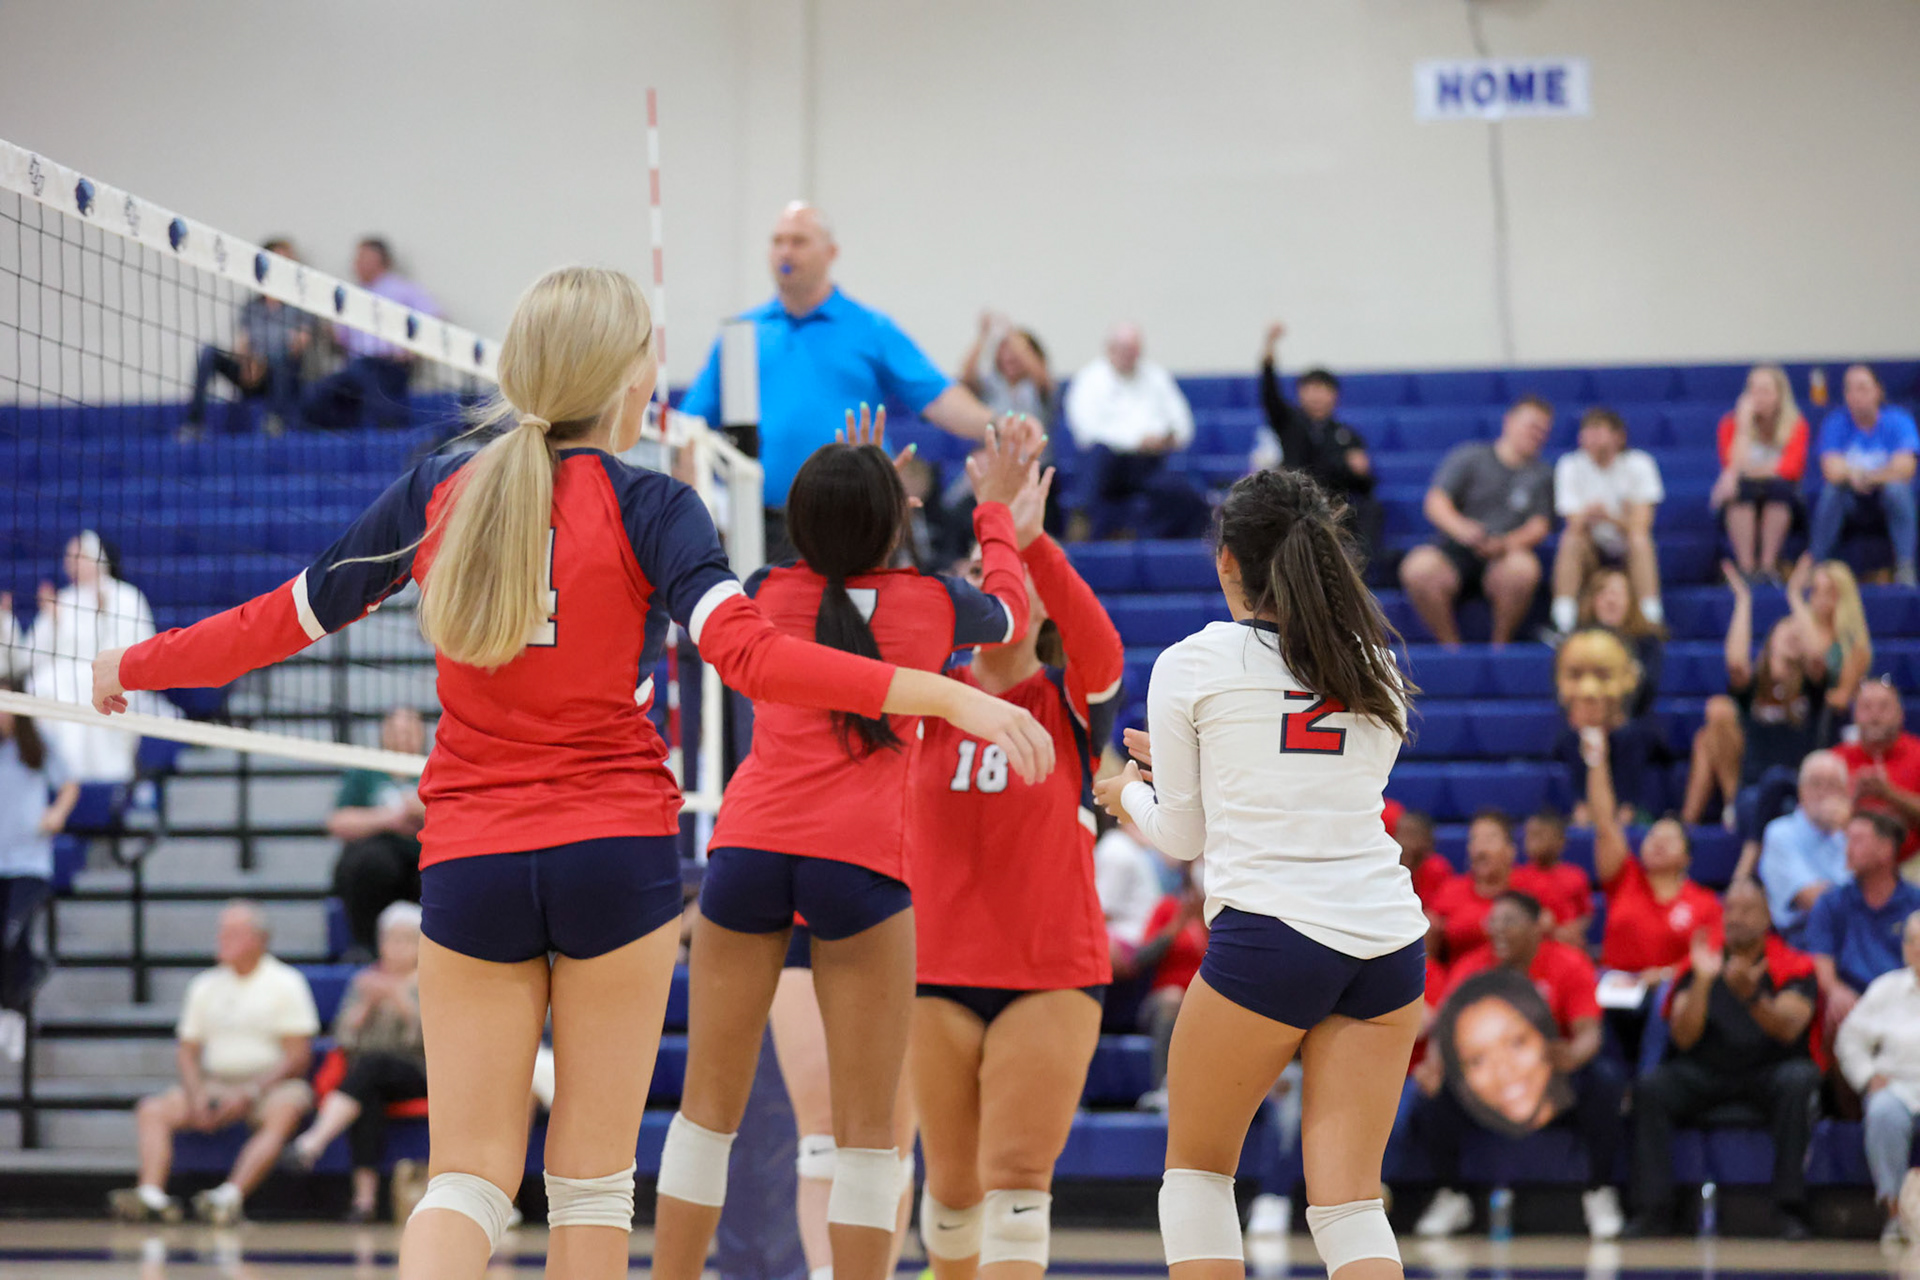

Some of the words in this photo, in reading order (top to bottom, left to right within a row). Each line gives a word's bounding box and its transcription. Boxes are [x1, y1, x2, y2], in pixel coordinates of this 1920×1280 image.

[1437, 67, 1567, 109] HOME
[1280, 690, 1350, 755] 2
[950, 739, 1009, 794] 18
